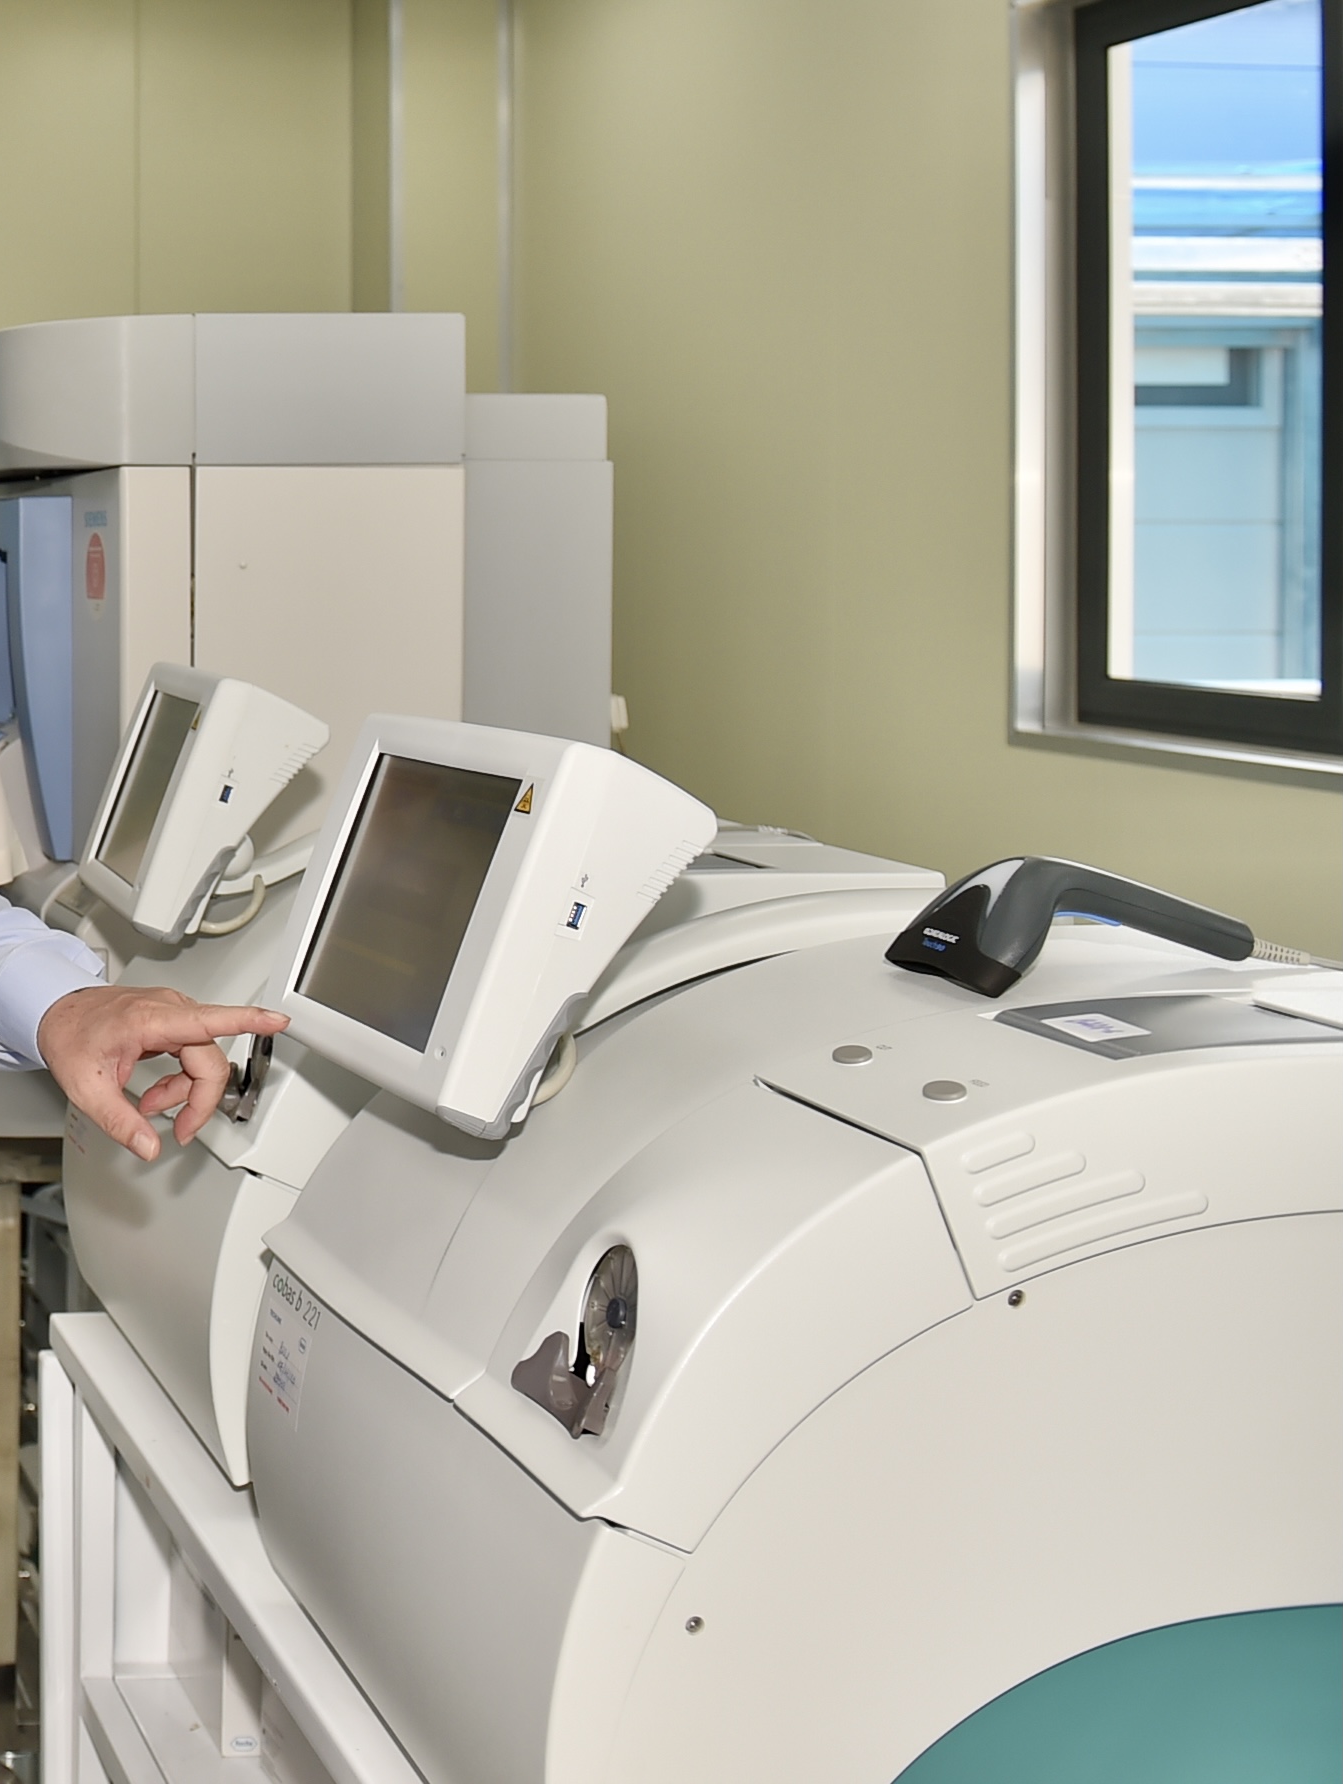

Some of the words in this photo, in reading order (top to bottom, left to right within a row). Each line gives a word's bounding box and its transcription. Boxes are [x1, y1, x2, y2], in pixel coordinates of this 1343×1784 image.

[272, 1273, 296, 1305] cobas
[295, 1290, 303, 1312] b
[302, 1300, 321, 1331] 221
